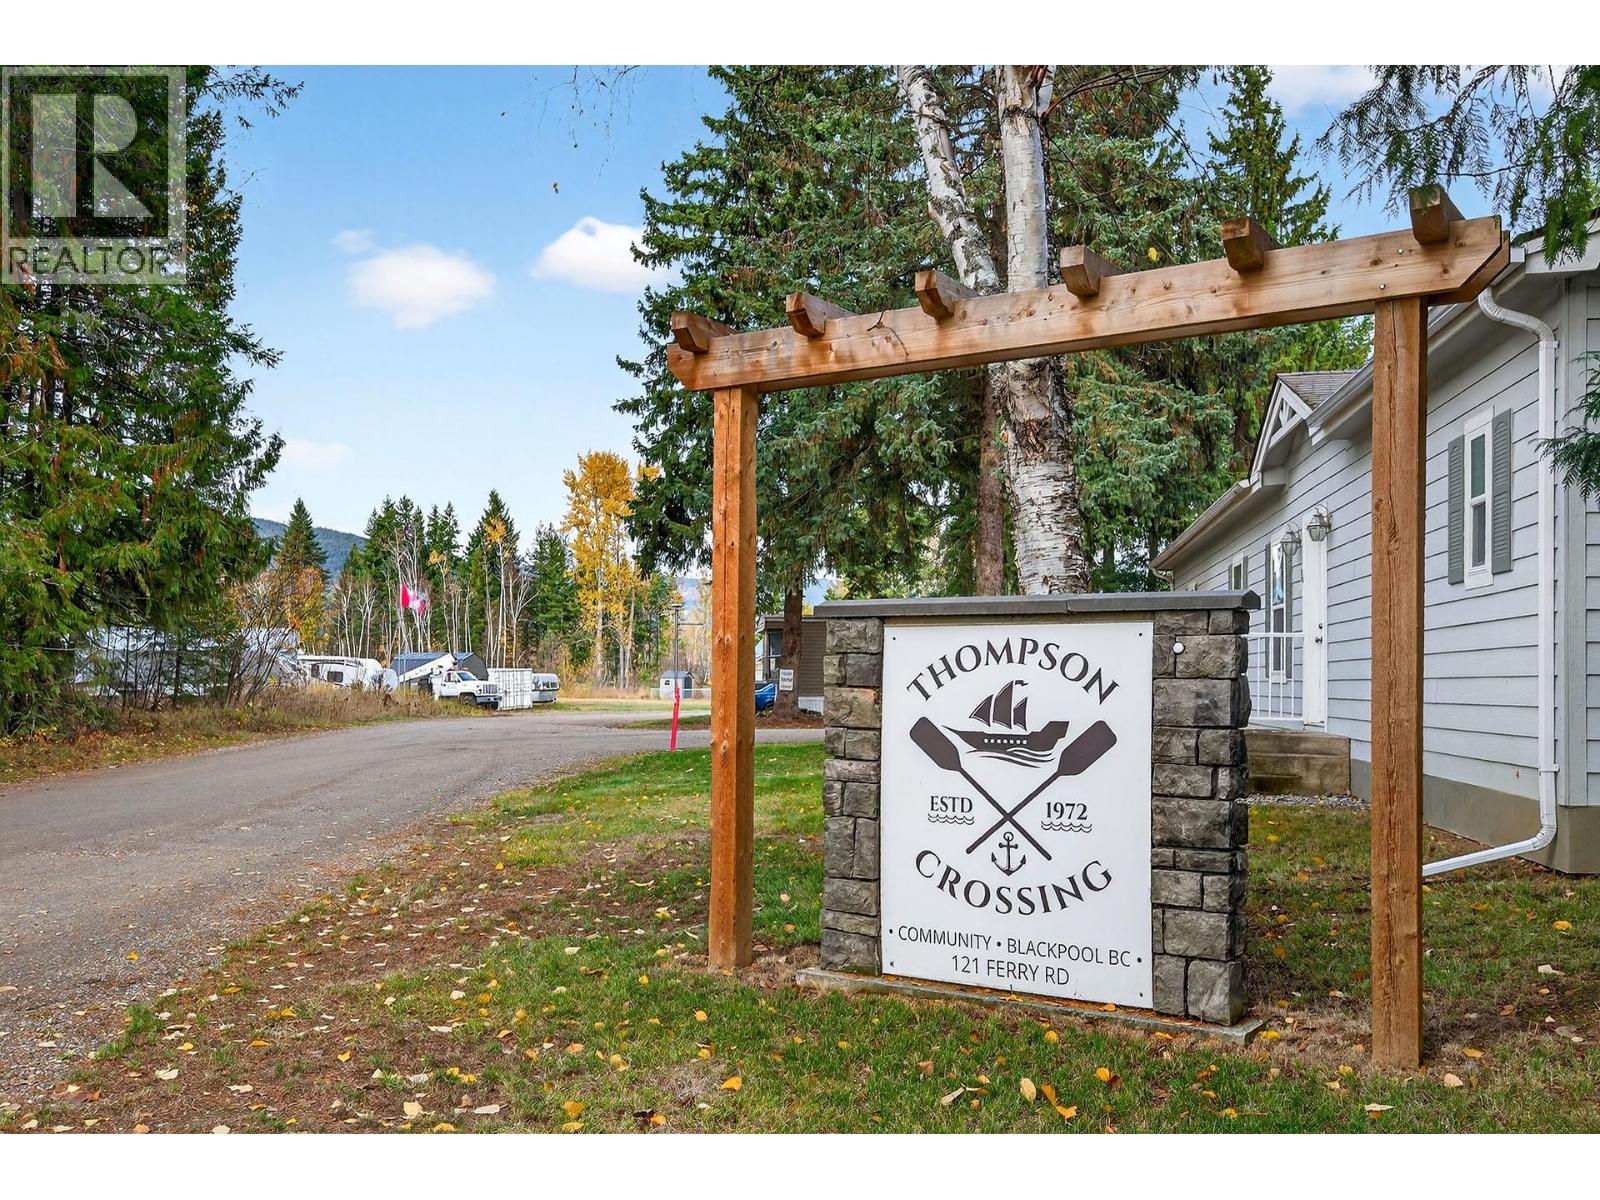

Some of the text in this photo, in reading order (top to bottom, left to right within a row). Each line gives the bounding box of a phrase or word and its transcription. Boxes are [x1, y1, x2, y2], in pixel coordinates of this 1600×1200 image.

[907, 637, 1119, 705] THOMPSON
[930, 795, 973, 814] ESTD
[1046, 801, 1088, 821] 1972
[915, 849, 1112, 916] CROSSING
[898, 925, 1131, 967] COMMUNITY BLACKPOOL BC
[952, 955, 1070, 985] 121 FERRY RD
